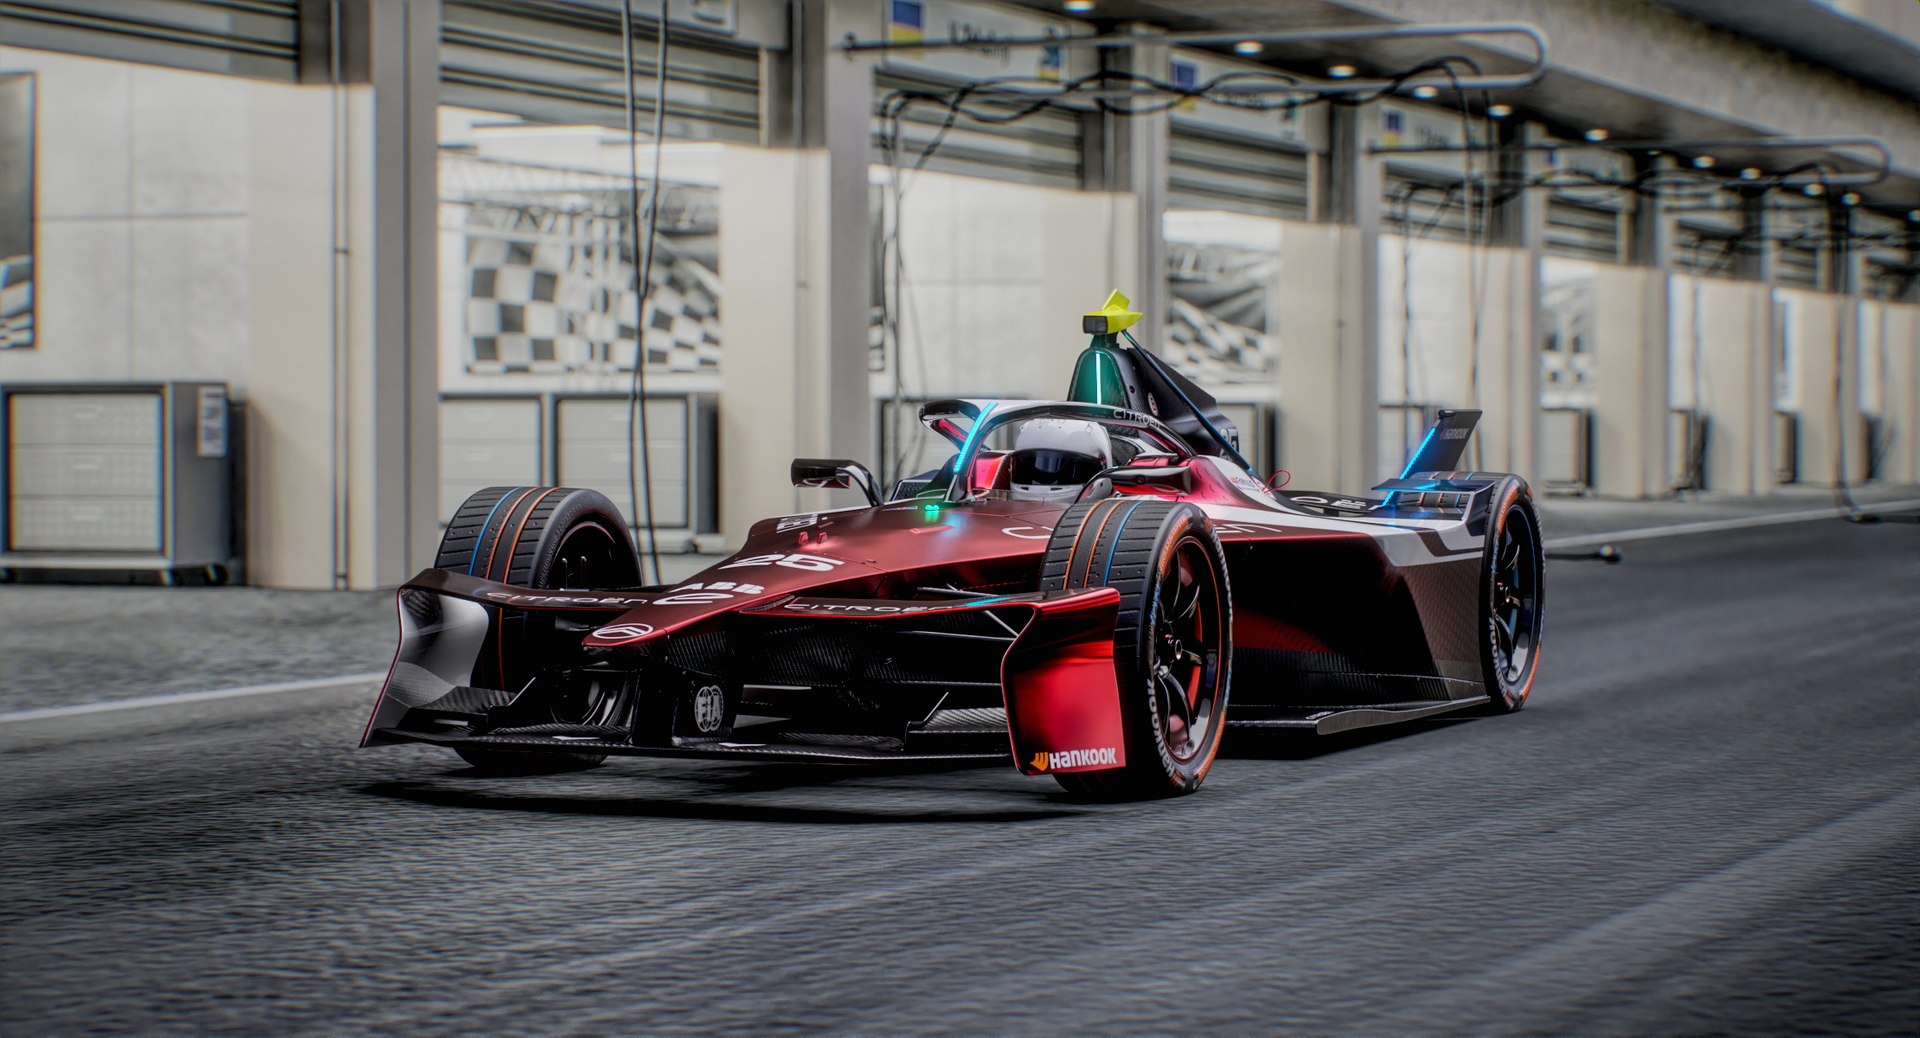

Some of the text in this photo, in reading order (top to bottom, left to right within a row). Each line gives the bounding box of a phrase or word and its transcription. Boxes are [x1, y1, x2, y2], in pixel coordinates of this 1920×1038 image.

[718, 554, 845, 572] 25
[670, 581, 764, 596] ABB
[698, 696, 721, 723] FIA
